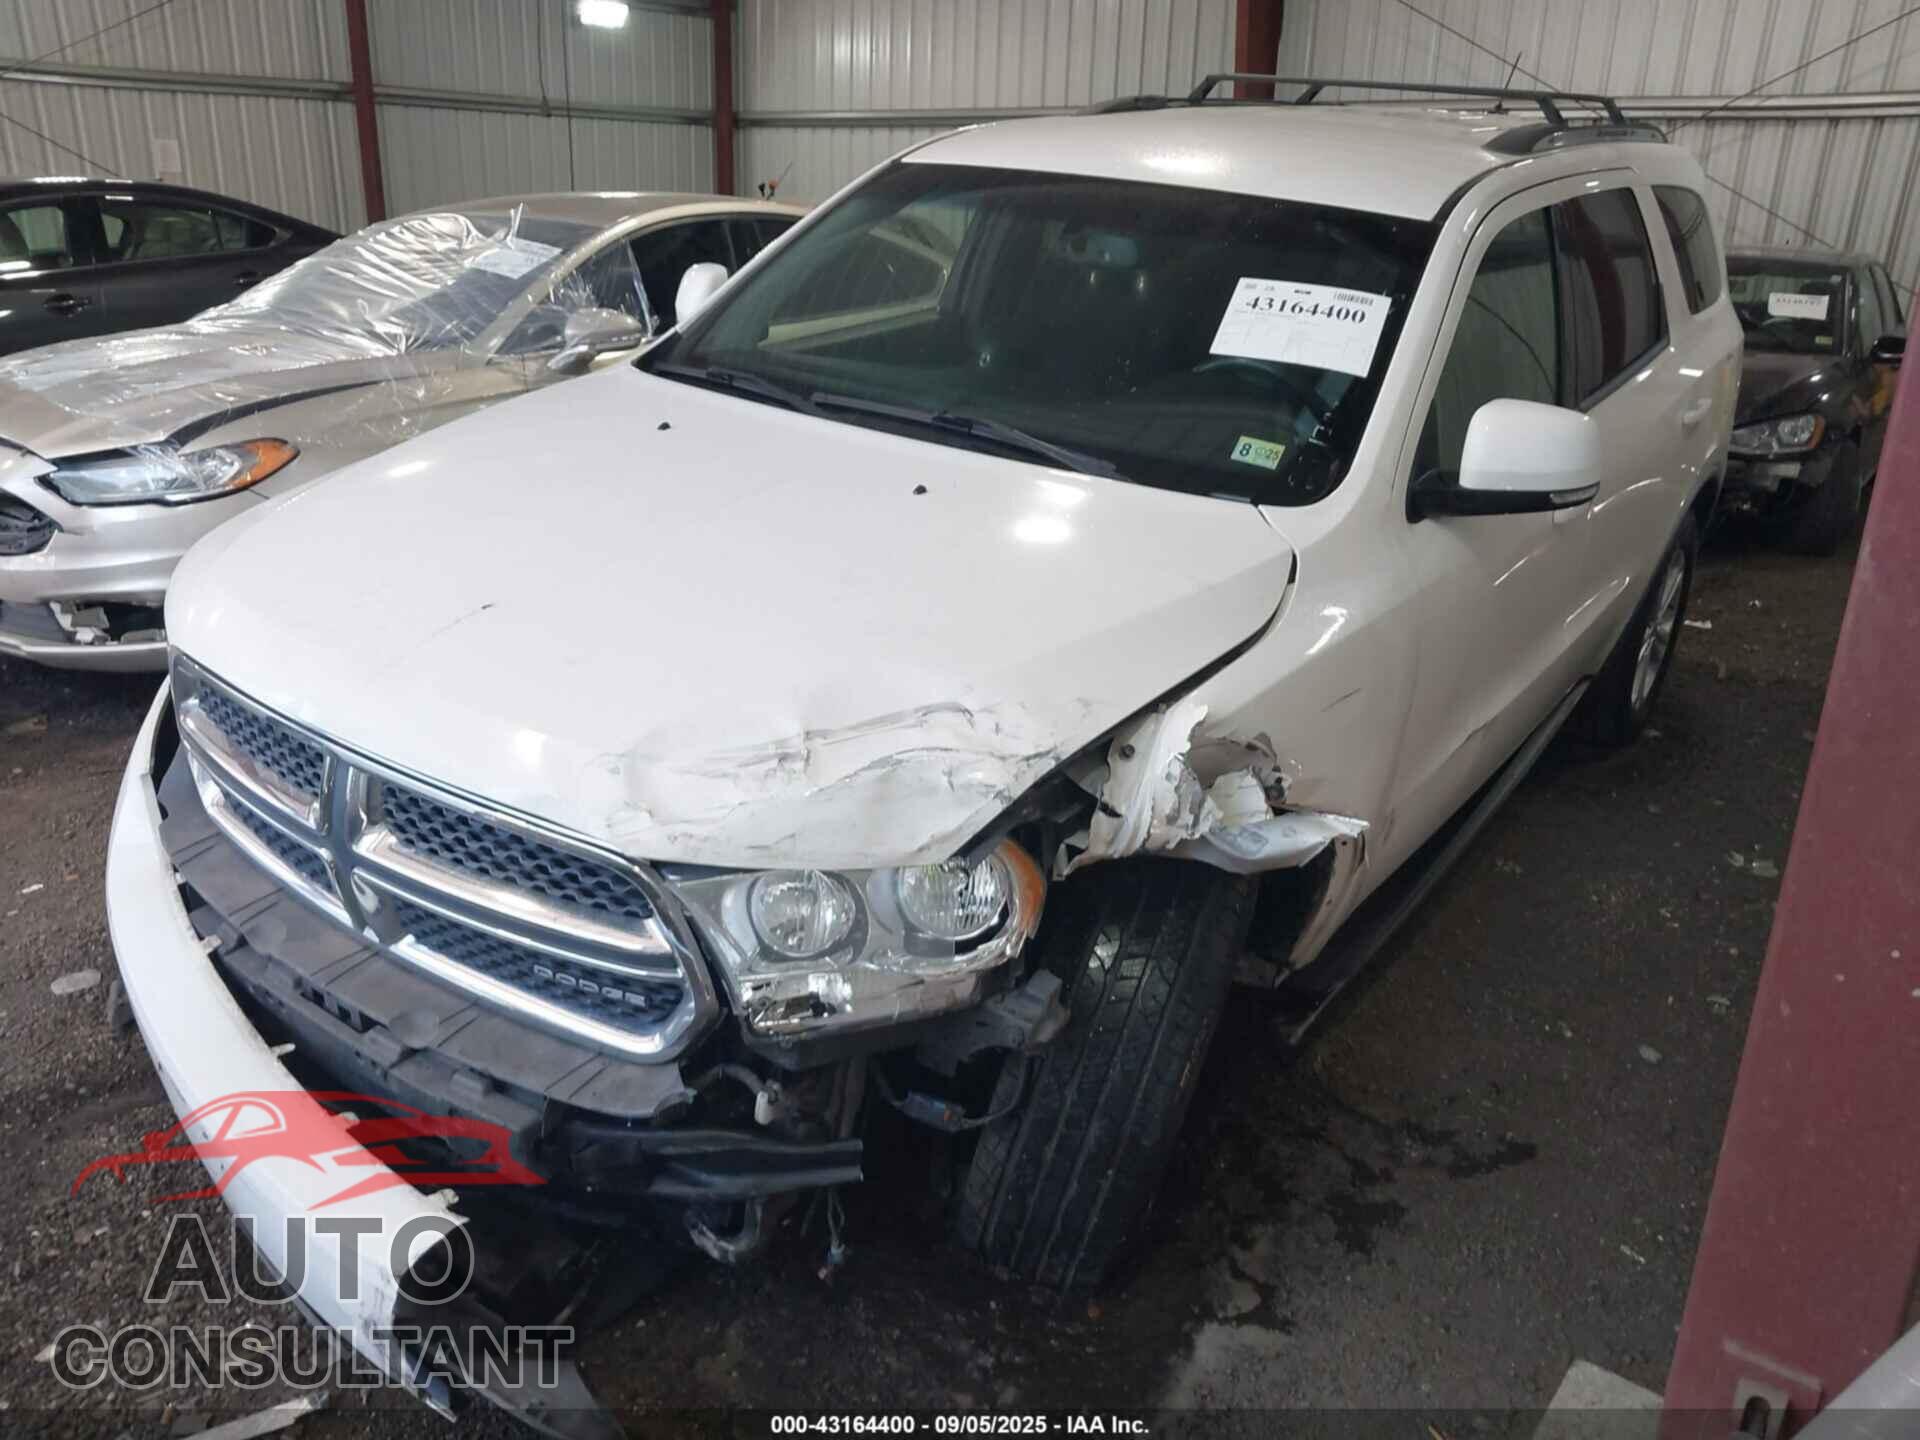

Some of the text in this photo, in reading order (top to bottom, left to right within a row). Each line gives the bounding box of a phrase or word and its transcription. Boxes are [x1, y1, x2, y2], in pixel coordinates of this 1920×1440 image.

[1245, 296, 1366, 324] 43164400
[1239, 443, 1252, 456] 8
[533, 964, 646, 1008] DODGE
